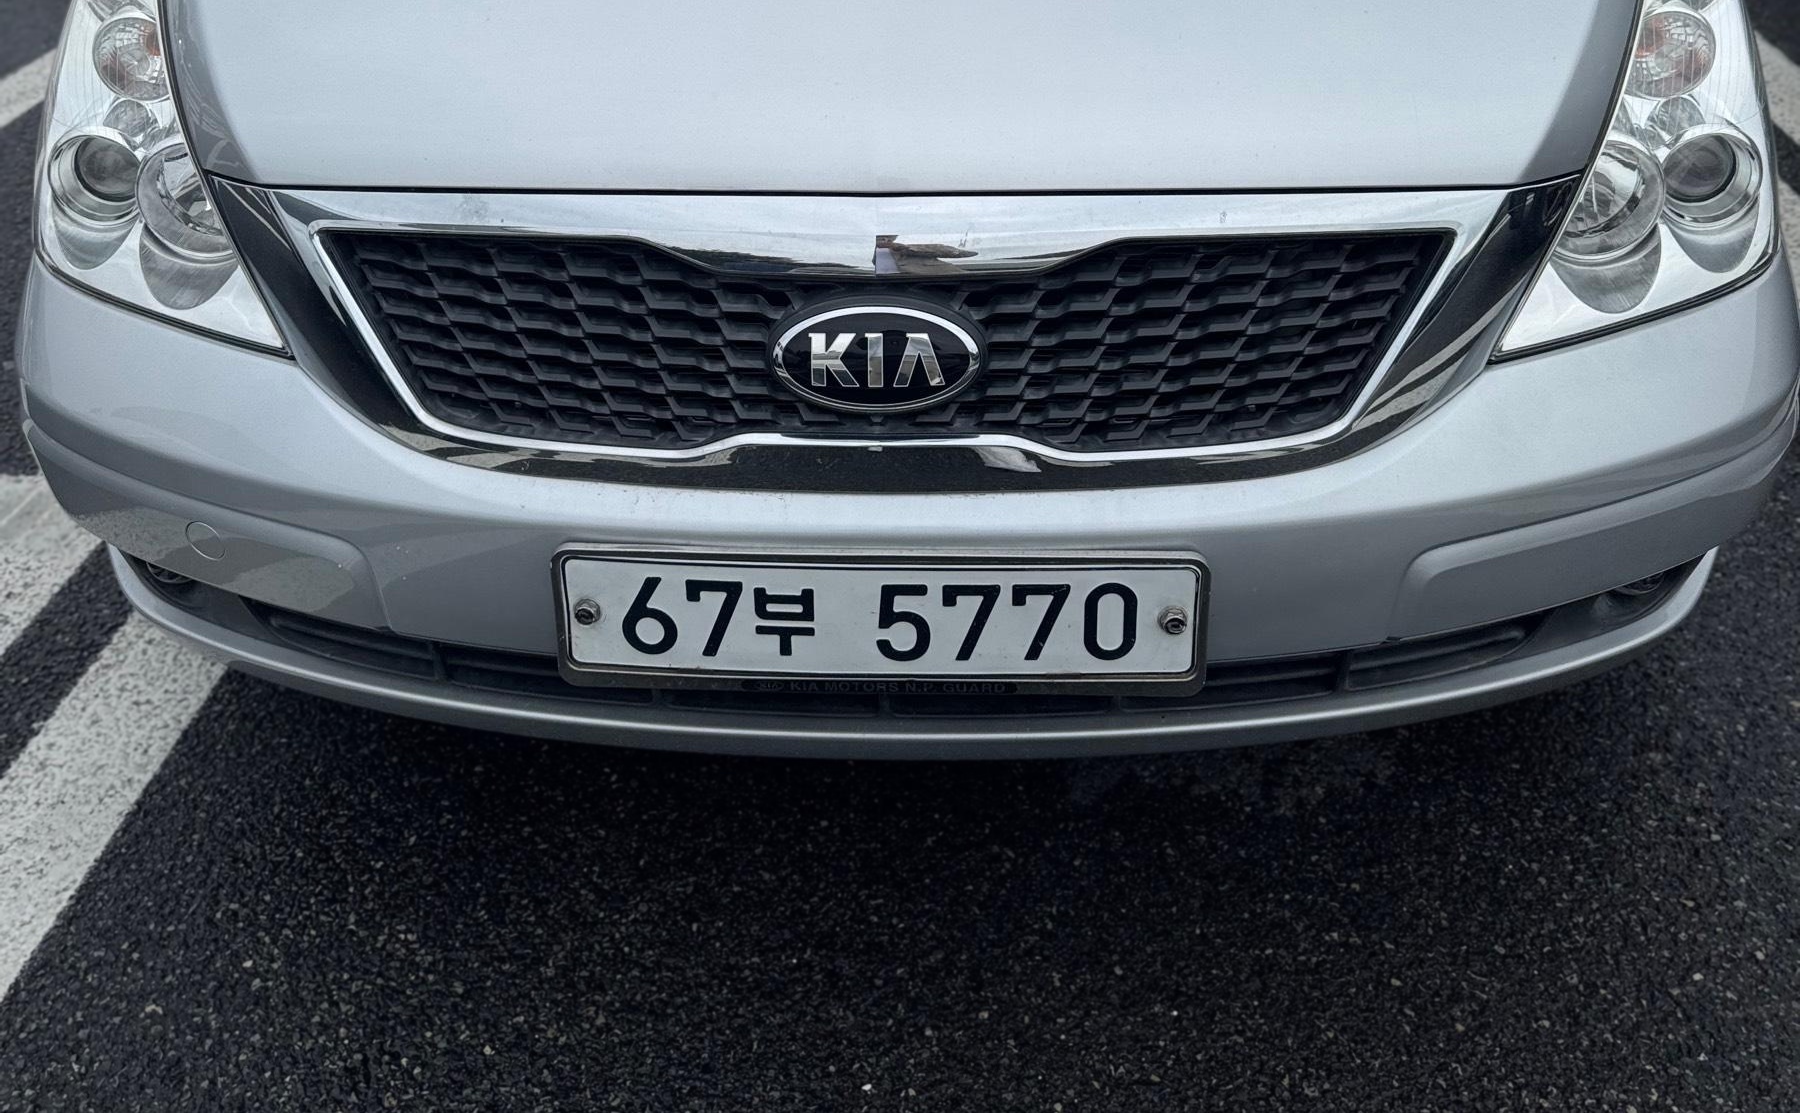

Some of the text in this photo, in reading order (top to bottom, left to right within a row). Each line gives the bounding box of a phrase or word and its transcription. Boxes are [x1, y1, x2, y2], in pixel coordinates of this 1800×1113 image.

[808, 332, 946, 387] KIA
[621, 576, 1139, 662] 67부 5770
[789, 681, 819, 692] KIA
[824, 681, 899, 693] MOTORS
